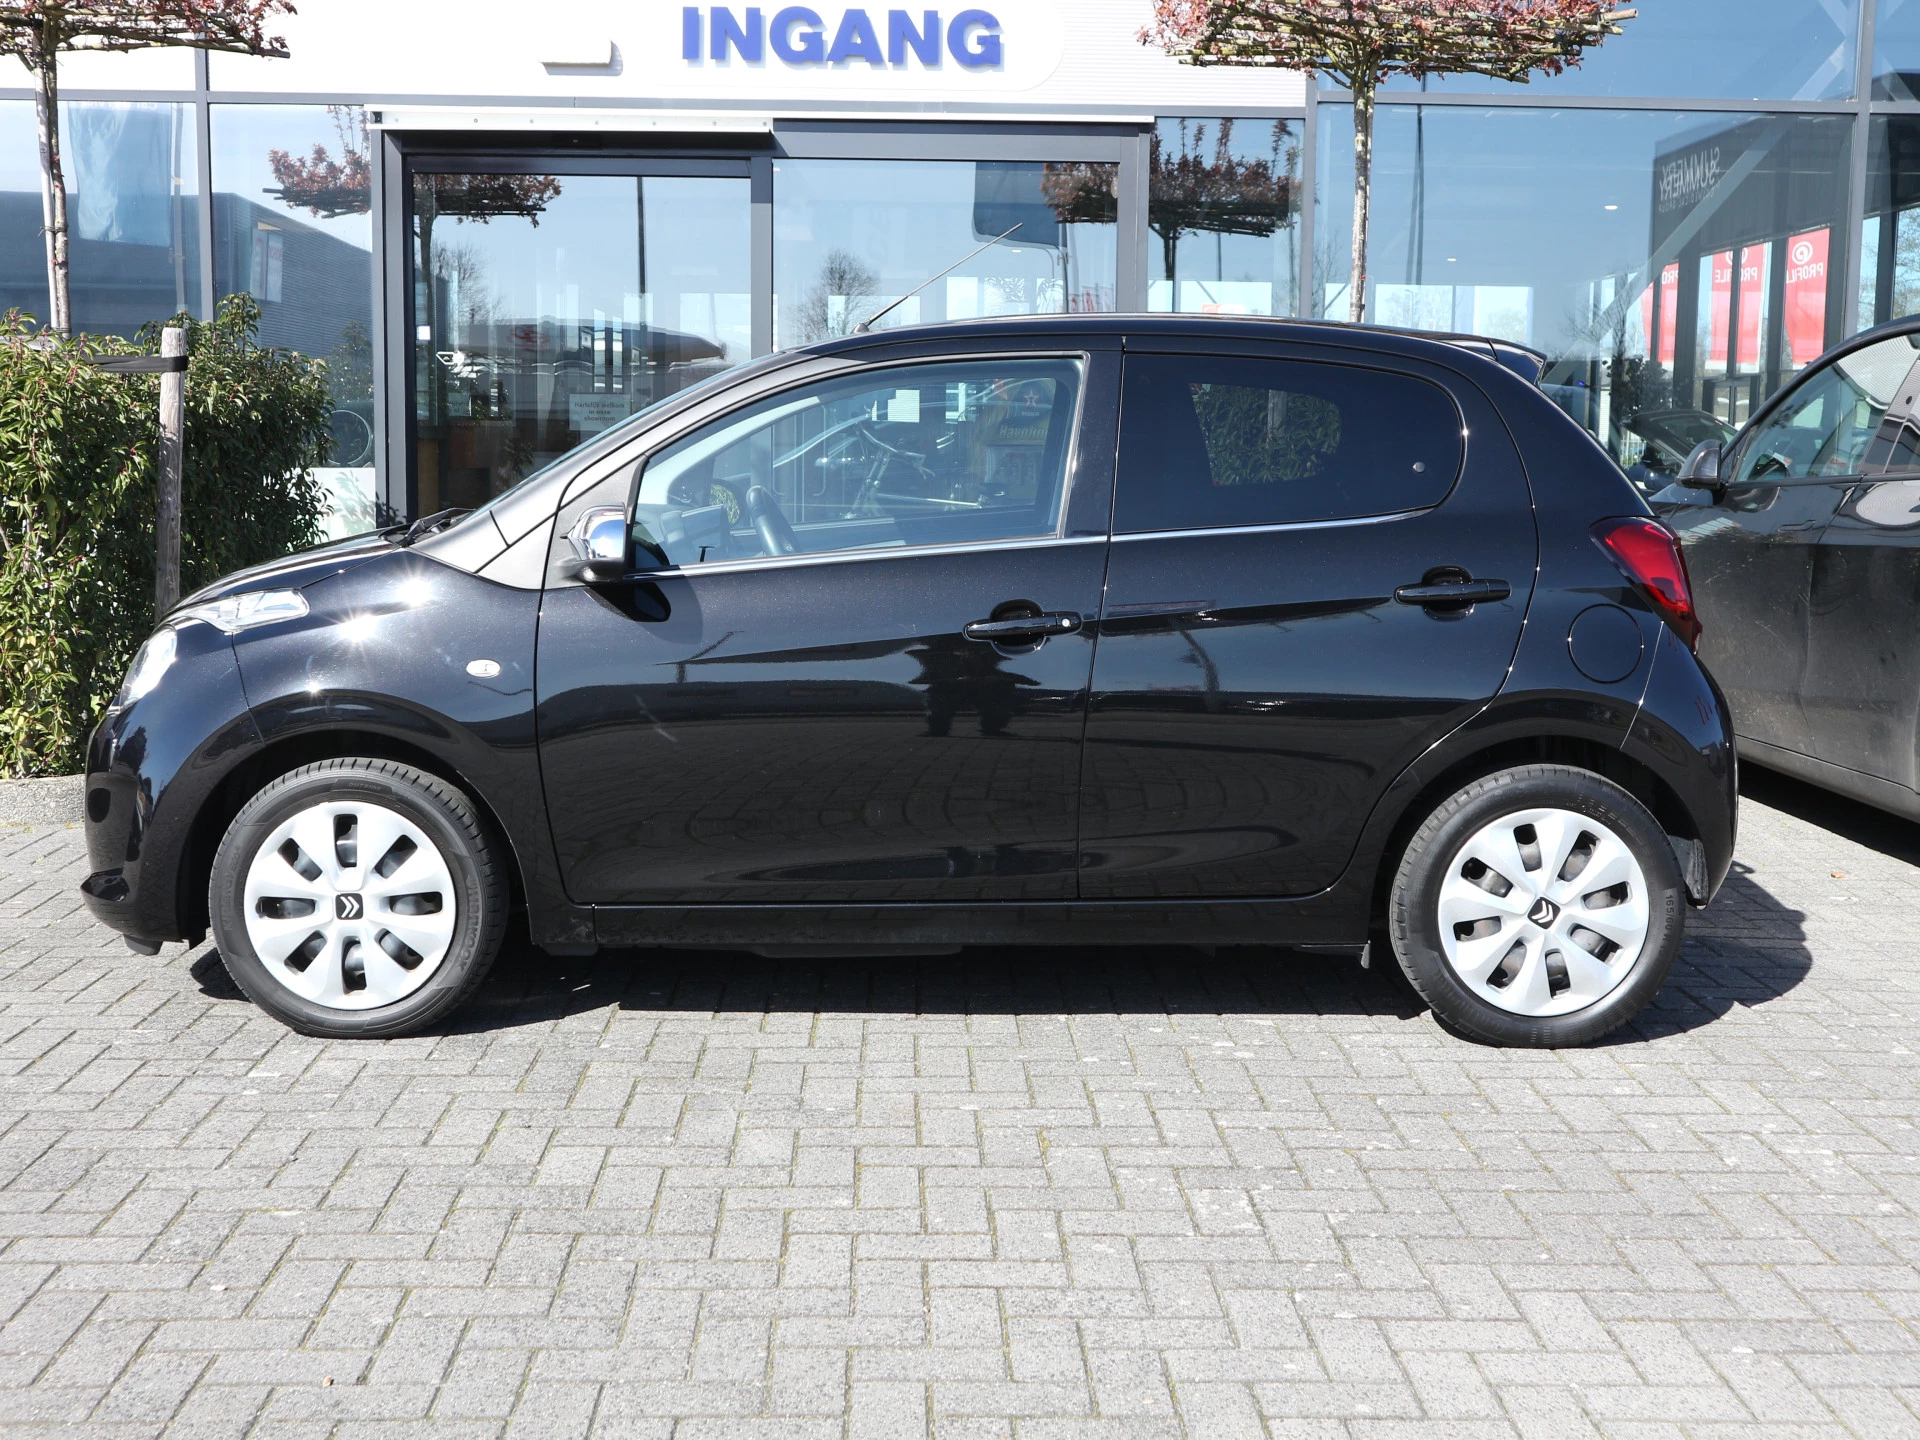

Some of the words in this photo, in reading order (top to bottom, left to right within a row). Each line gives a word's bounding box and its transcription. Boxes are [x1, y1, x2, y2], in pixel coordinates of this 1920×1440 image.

[682, 6, 1002, 68] INGANG
[1000, 425, 1048, 439] Havolin
[1664, 894, 1675, 930] 165/60
